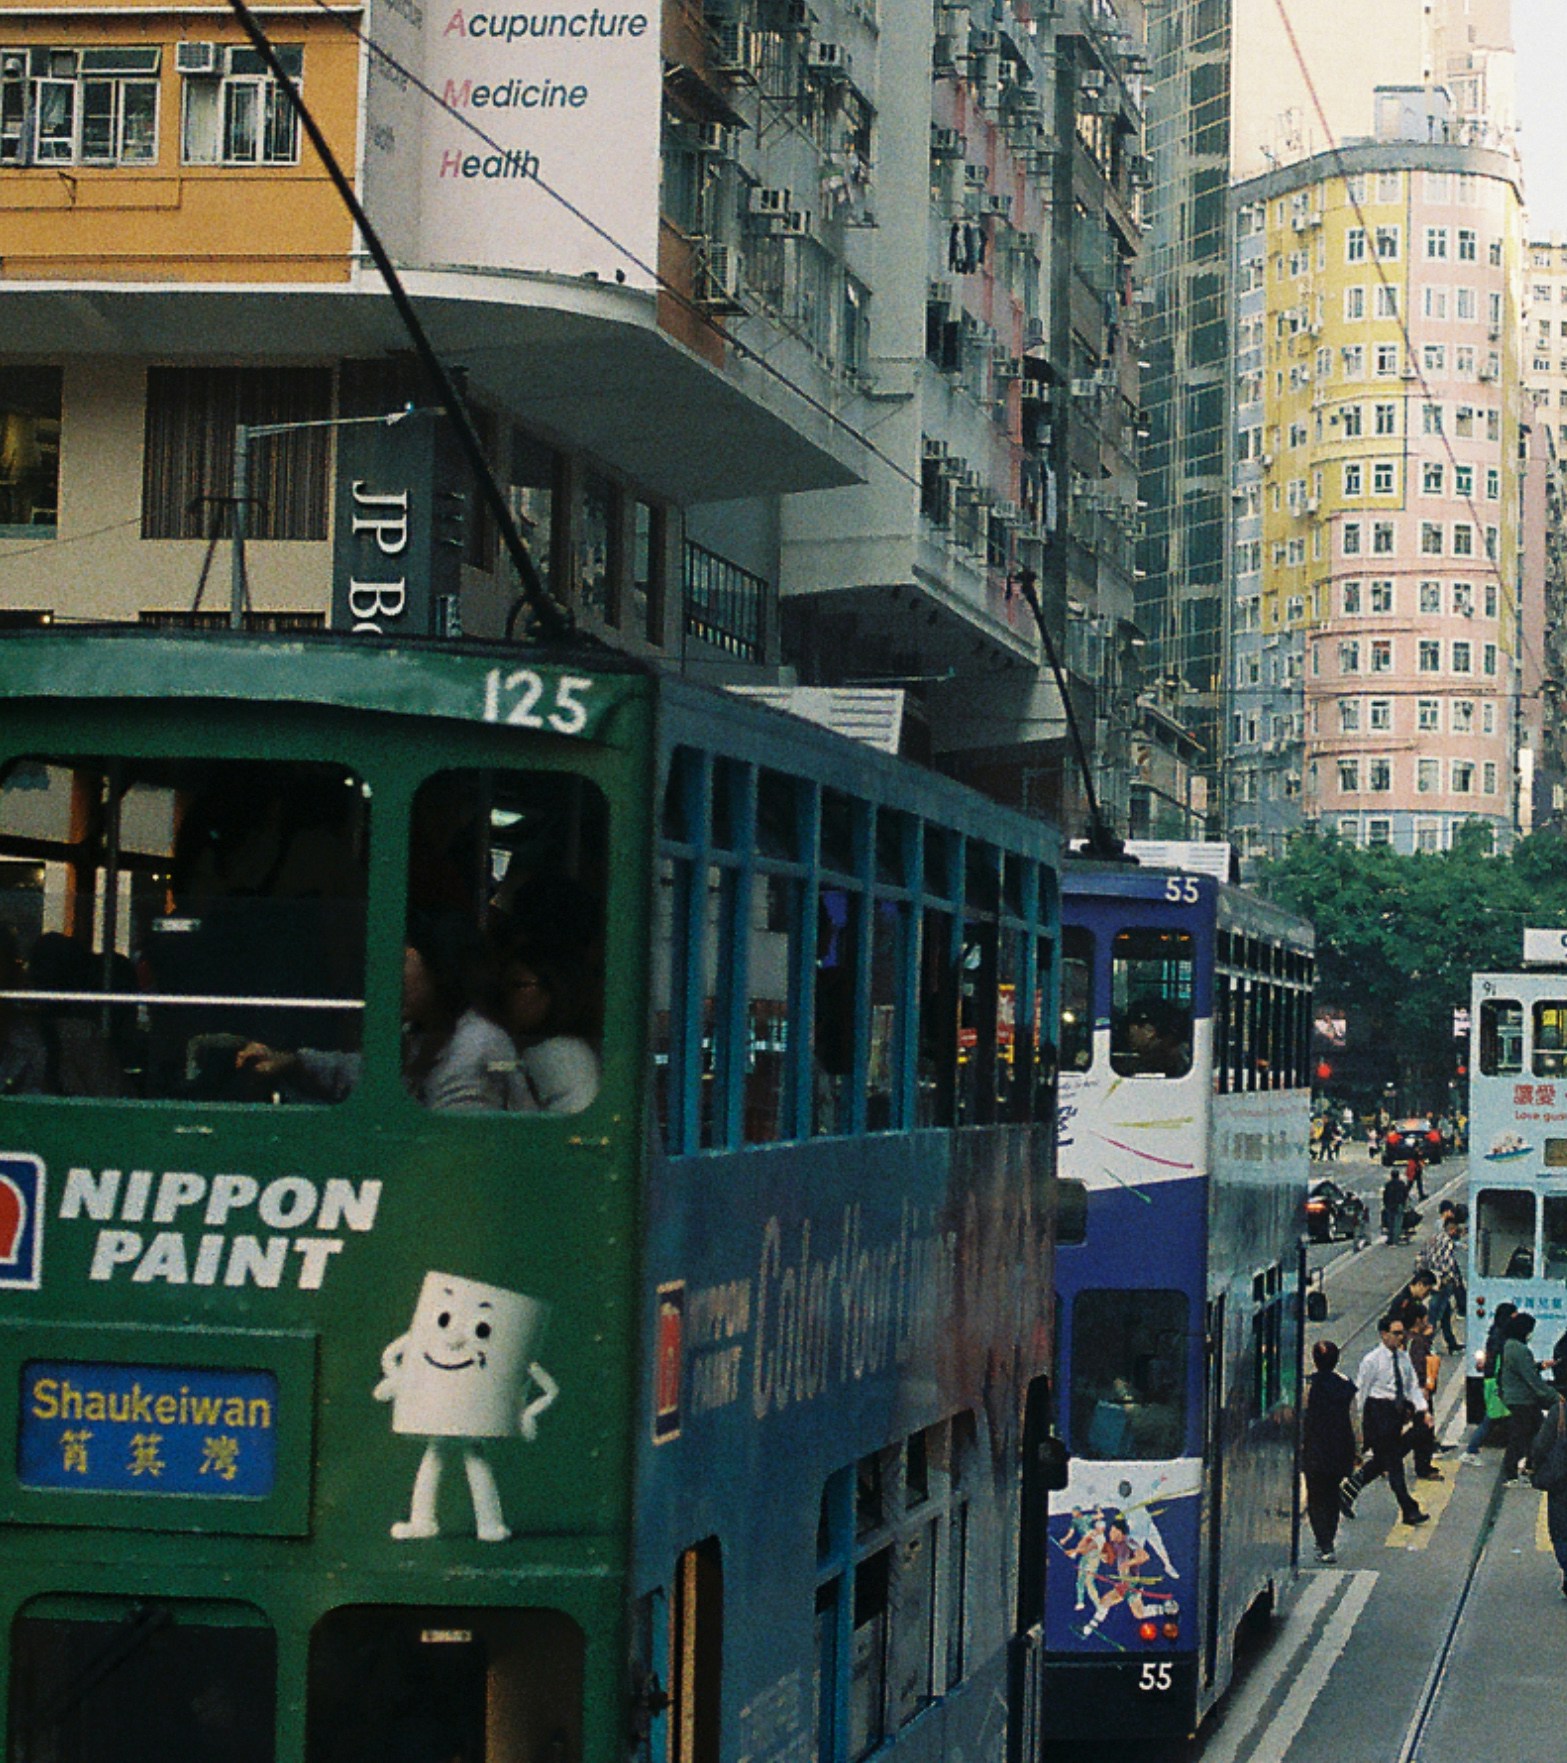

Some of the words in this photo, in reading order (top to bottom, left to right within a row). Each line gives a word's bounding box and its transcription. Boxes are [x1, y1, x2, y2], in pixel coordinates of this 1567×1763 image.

[443, 8, 648, 43] Acupuncture
[443, 78, 588, 109] Medicine
[439, 150, 540, 179] Health
[351, 480, 409, 555] JP
[481, 667, 594, 735] 125
[1164, 876, 1199, 903] 55
[1482, 981, 1497, 997] 91
[59, 1168, 383, 1232] NIPPON
[89, 1229, 345, 1290] PAINT
[32, 1378, 272, 1429] Shaukeiwan
[59, 1428, 241, 1482] 筲箕灣
[1138, 1662, 1174, 1690] 55
